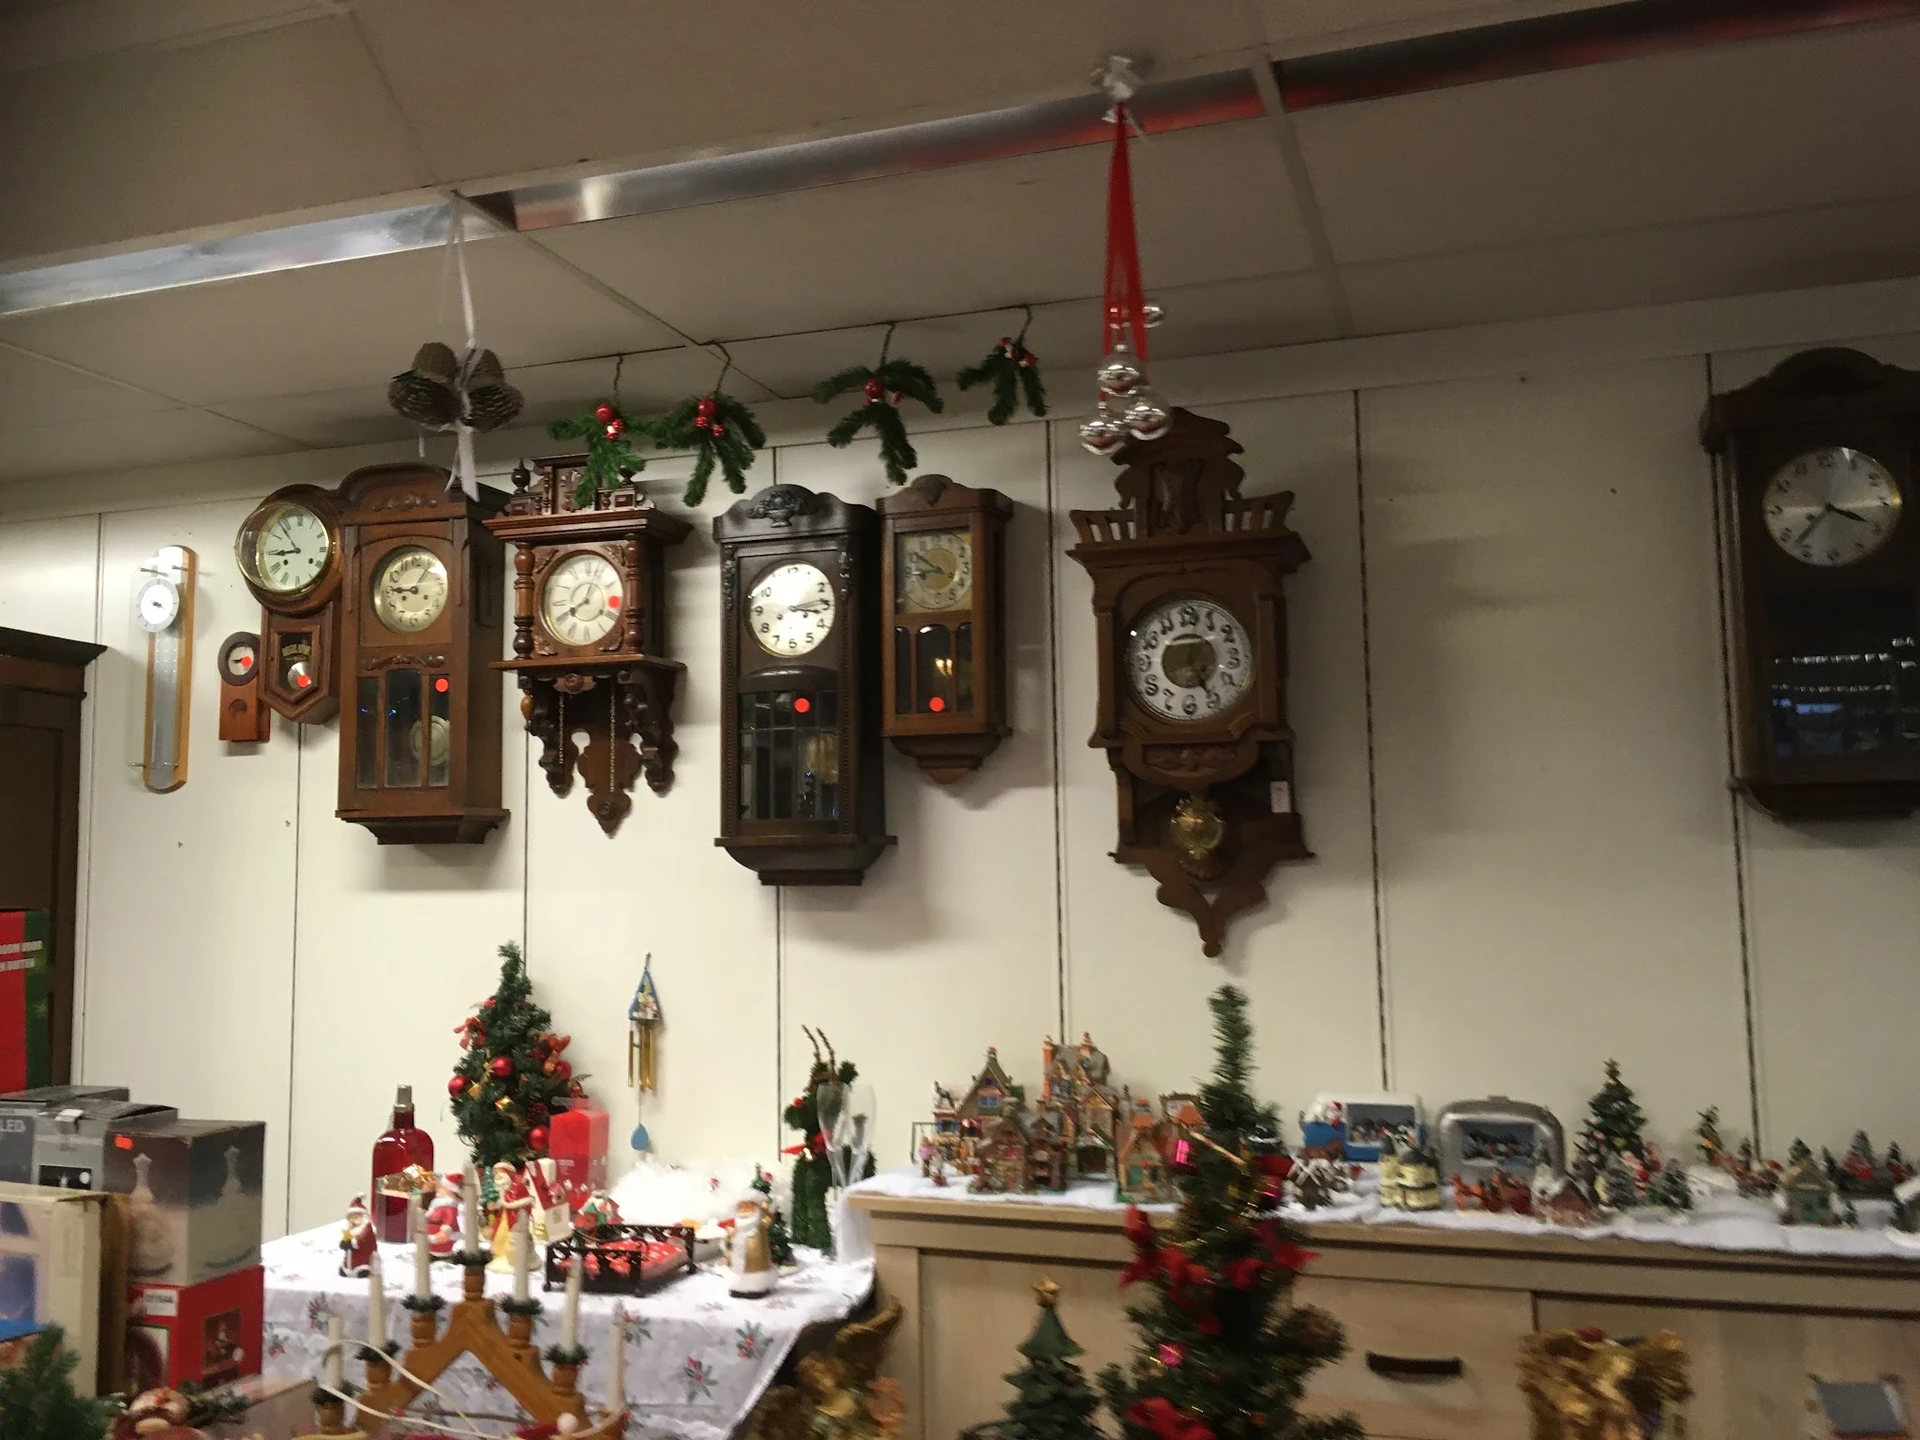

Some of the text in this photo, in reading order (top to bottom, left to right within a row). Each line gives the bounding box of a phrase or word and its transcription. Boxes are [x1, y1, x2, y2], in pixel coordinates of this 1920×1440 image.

[760, 586, 772, 598] 10
[817, 582, 825, 593] 2
[754, 605, 764, 617] 9
[819, 598, 831, 611] 3
[816, 618, 825, 629] 4
[1158, 612, 1174, 636] 11
[1179, 604, 1200, 628] 12
[1205, 610, 1215, 632] 1
[760, 622, 770, 634] 8
[804, 632, 815, 644] 5
[1221, 623, 1236, 644] 2
[772, 634, 781, 646] 7
[788, 638, 798, 649] 6
[1142, 630, 1159, 650] 10
[1136, 652, 1152, 673] 9
[1225, 647, 1241, 670] 3
[1144, 673, 1159, 697] 8
[1163, 687, 1176, 711] 7
[1181, 694, 1199, 716] 6
